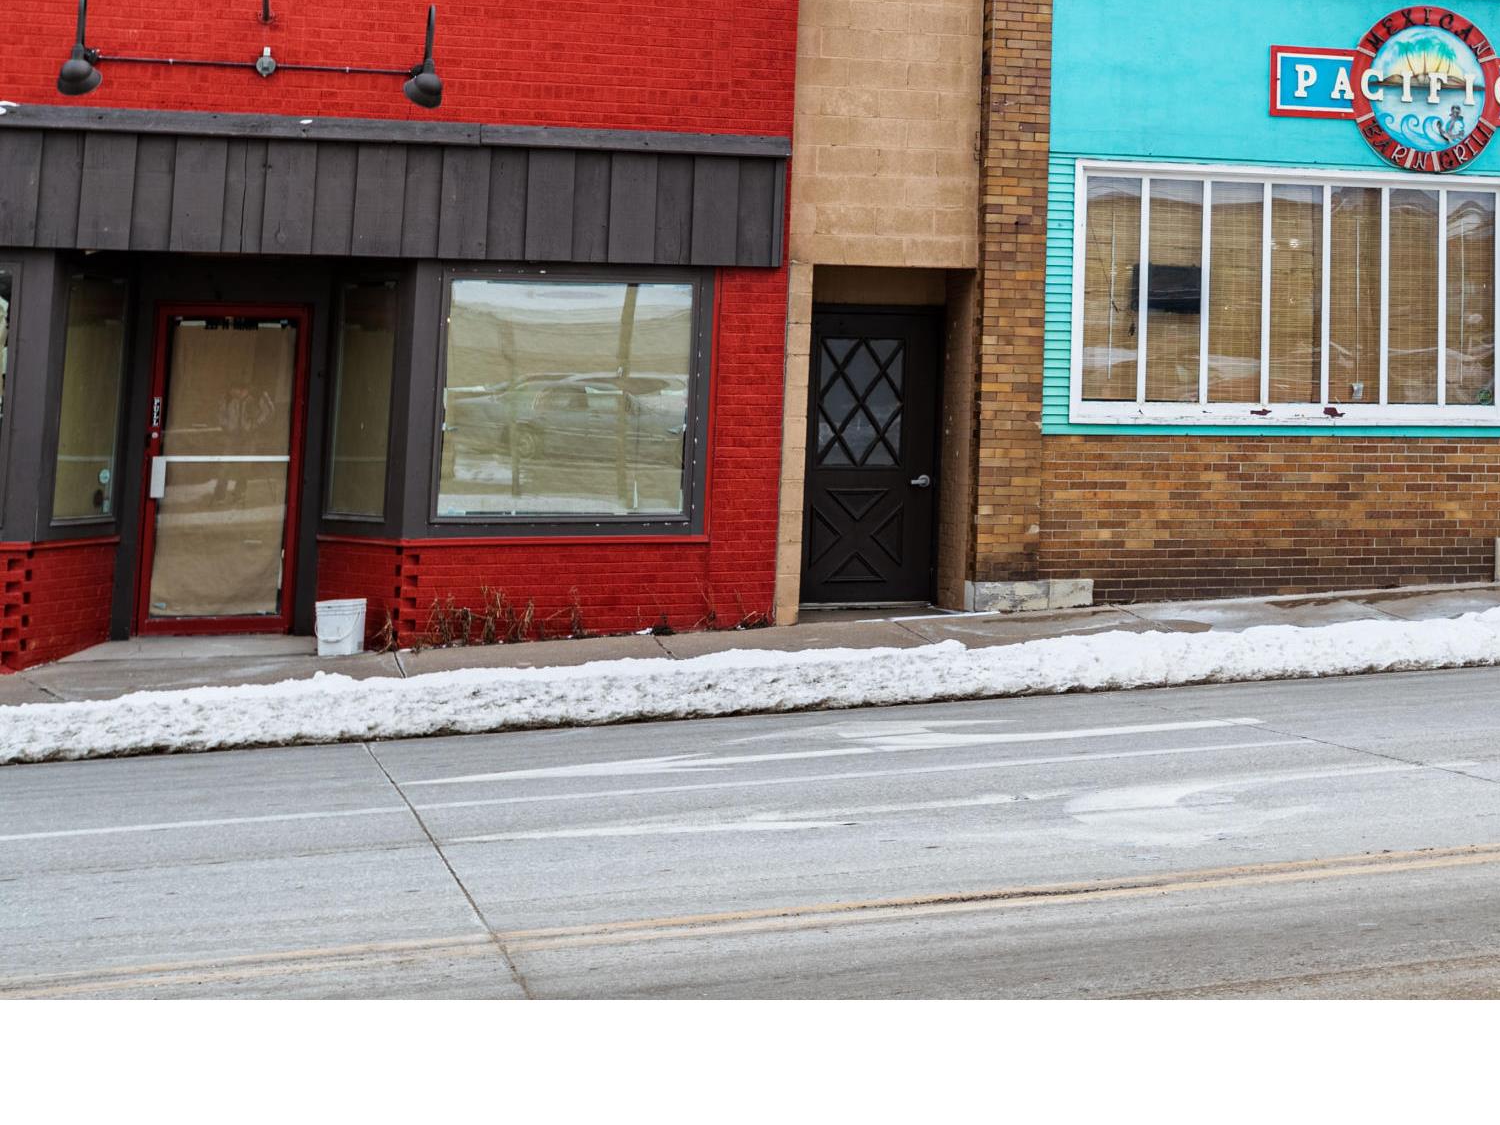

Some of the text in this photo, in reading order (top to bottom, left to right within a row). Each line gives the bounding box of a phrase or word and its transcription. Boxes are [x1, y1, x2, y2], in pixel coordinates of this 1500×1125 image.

[1365, 7, 1491, 58] MEXICAN
[1362, 119, 1407, 163] BAR
[1440, 124, 1494, 169] GRILL
